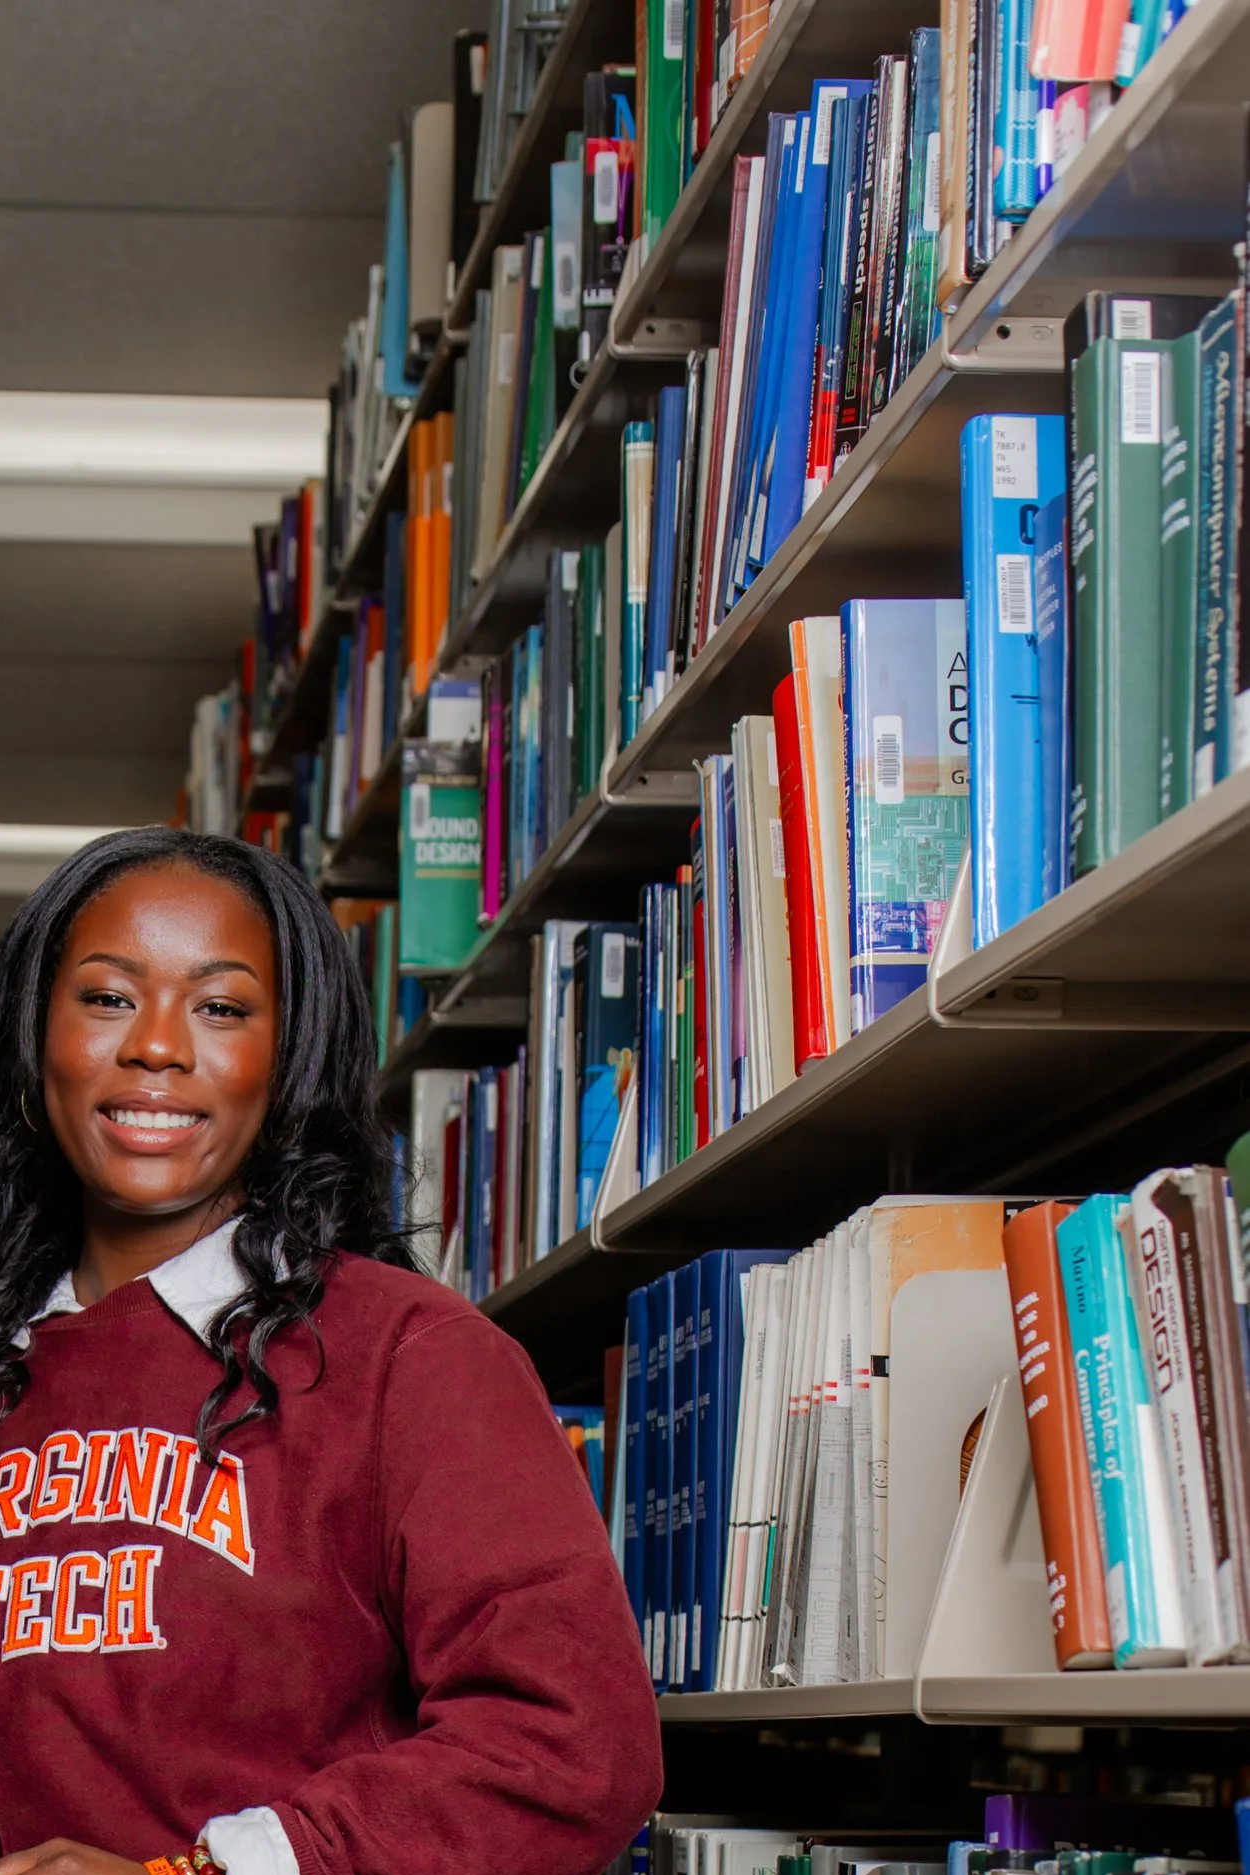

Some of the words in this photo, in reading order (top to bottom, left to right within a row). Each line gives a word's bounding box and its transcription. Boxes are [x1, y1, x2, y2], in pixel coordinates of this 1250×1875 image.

[864, 96, 878, 190] digital
[854, 197, 869, 295] speech
[995, 477, 1017, 485] 1992
[1207, 350, 1231, 598] Microcomputer
[1204, 606, 1225, 732] Systems
[842, 712, 851, 786] Advanced
[415, 841, 481, 865] DESIGN
[1071, 1245, 1087, 1315] Marino
[1074, 1348, 1099, 1465] Computer
[1092, 1333, 1120, 1452] Principles
[1103, 1456, 1124, 1480] of
